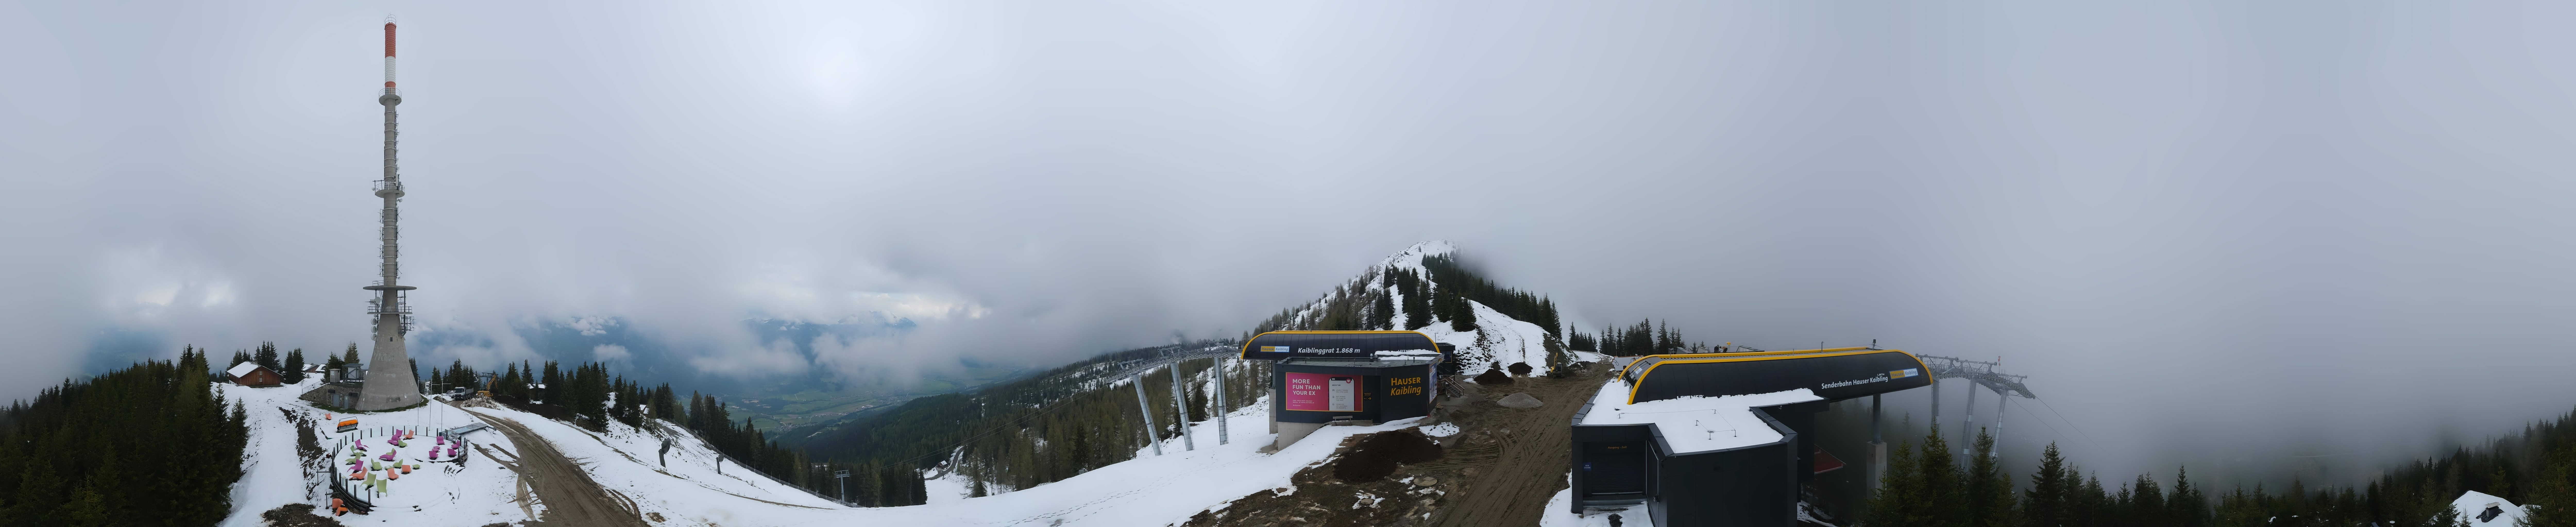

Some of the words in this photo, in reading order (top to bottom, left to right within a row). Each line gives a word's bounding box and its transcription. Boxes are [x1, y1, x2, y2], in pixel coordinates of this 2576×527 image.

[1391, 377, 1421, 386] HAUSER
[1821, 380, 1852, 389] Senderbahn
[1391, 386, 1421, 396] Kaibling
